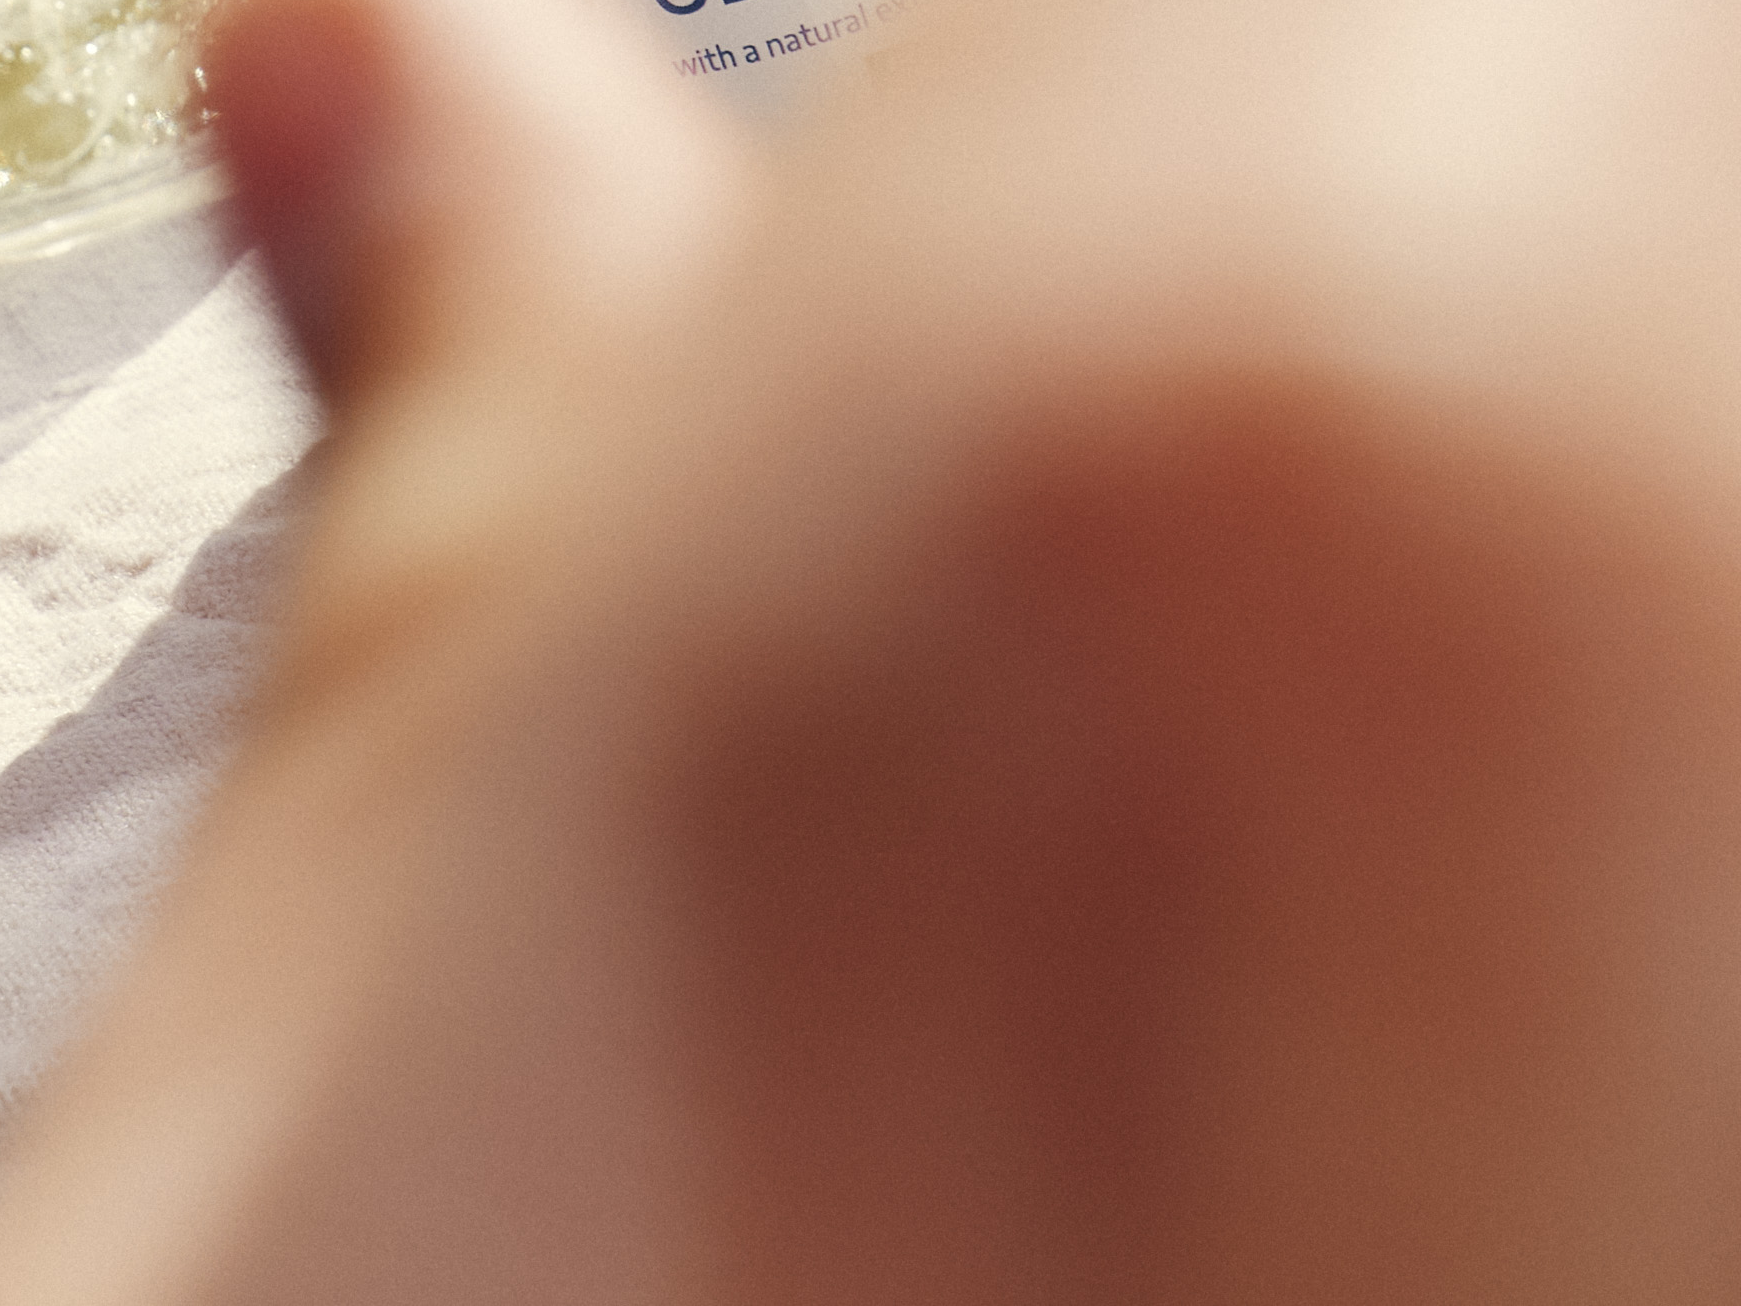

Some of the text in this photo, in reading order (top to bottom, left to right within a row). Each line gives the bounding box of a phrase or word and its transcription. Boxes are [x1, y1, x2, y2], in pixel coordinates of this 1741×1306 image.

[671, 44, 738, 80] with
[742, 39, 762, 65] a
[765, 2, 870, 60] natural
